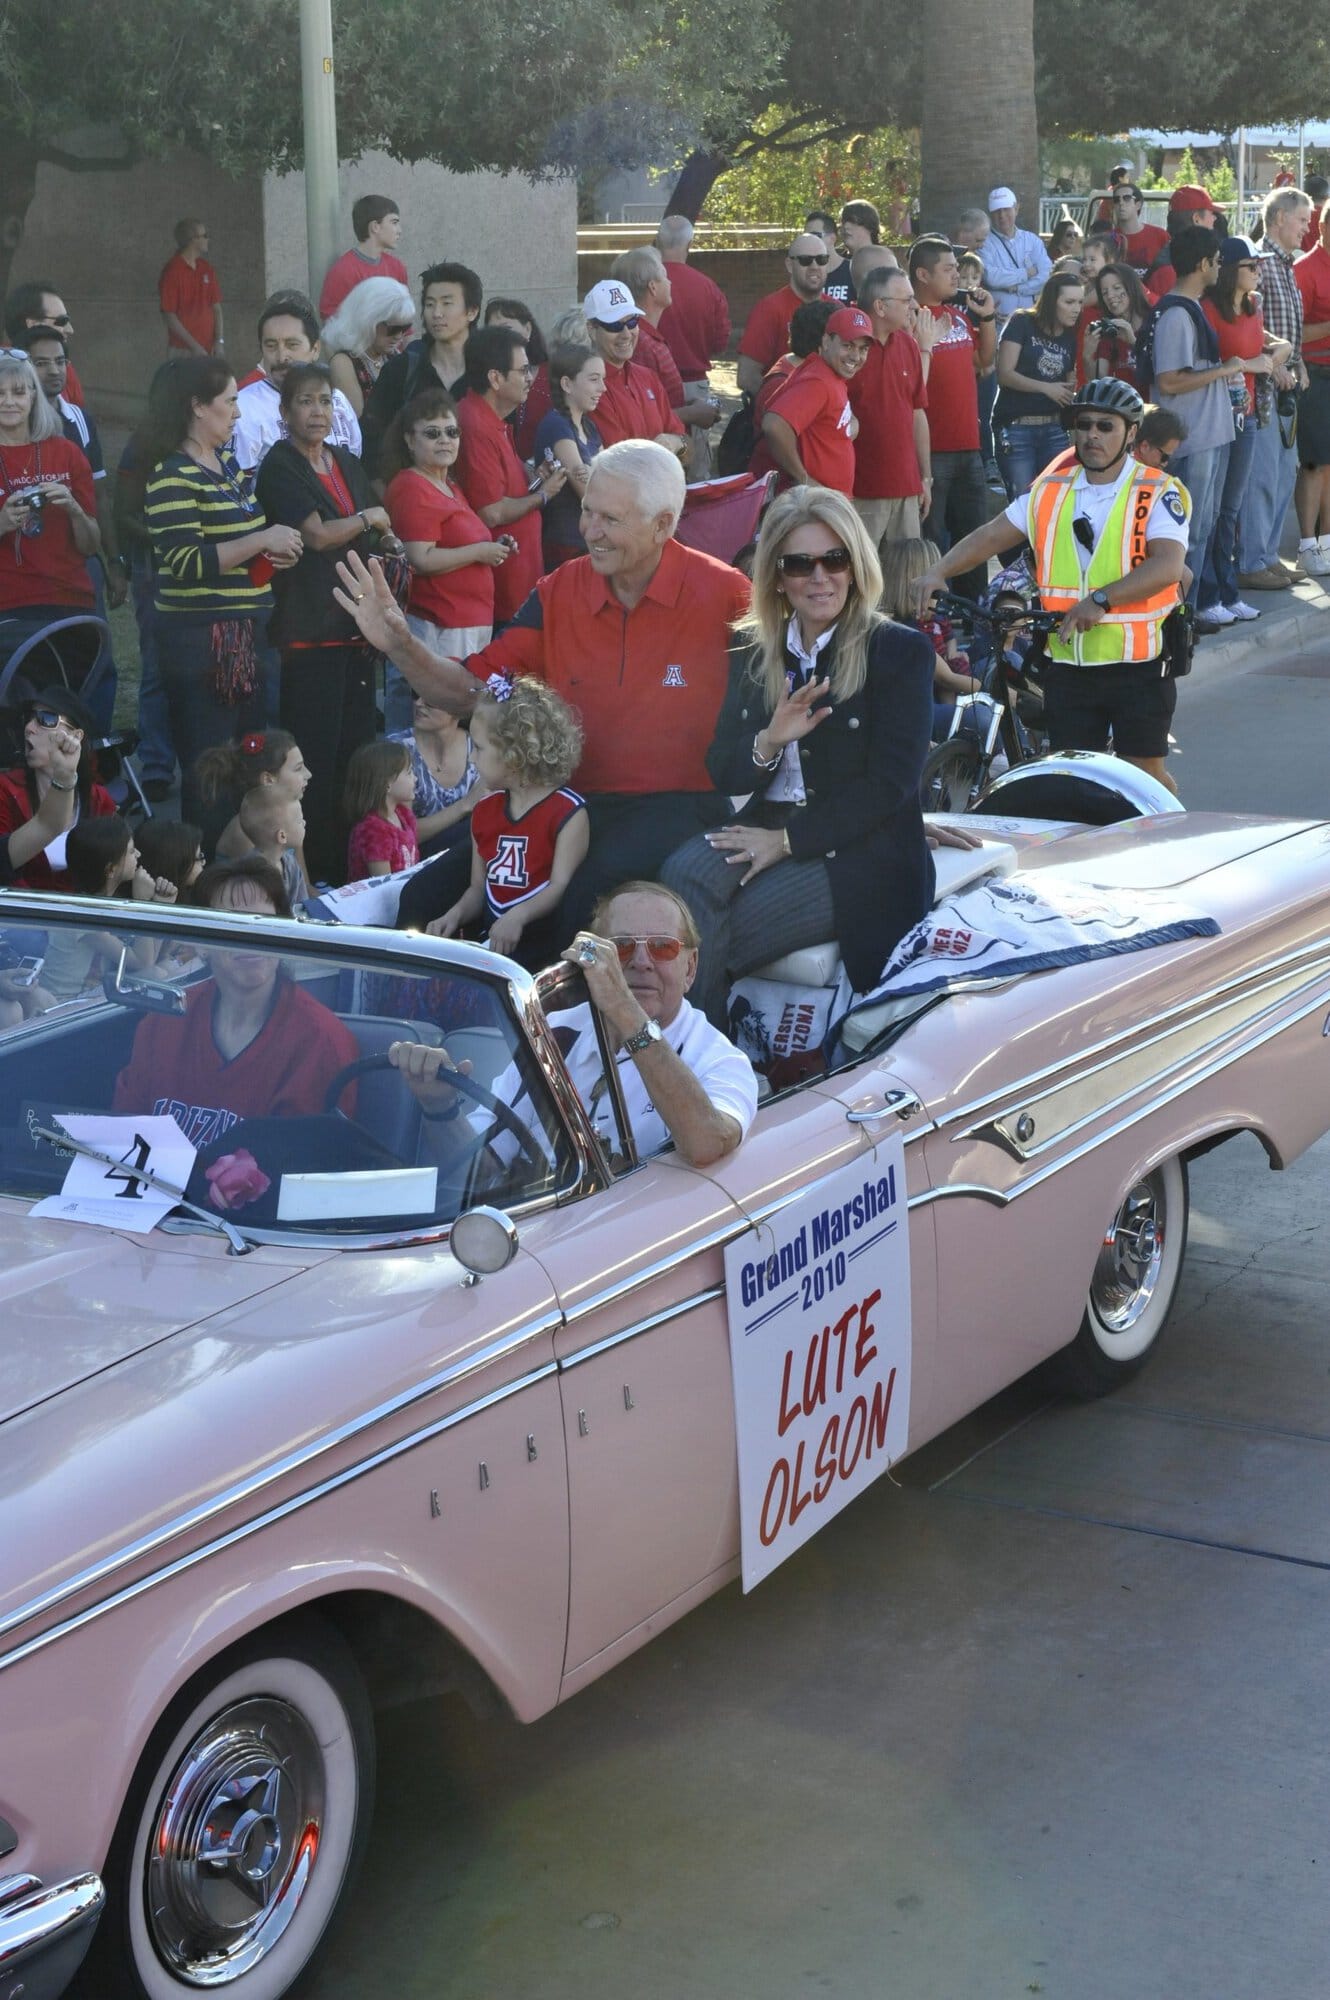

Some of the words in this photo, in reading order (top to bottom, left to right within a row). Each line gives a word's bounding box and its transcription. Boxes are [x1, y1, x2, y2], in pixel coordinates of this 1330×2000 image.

[609, 287, 627, 306] A
[663, 665, 686, 687] A
[487, 834, 528, 888] A
[104, 1133, 155, 1199] 4
[741, 1225, 808, 1308] Grand
[811, 1164, 897, 1260] Marshal
[801, 1251, 847, 1312] 2010
[777, 1288, 882, 1437] LUTE
[759, 1367, 897, 1547] OLSON
